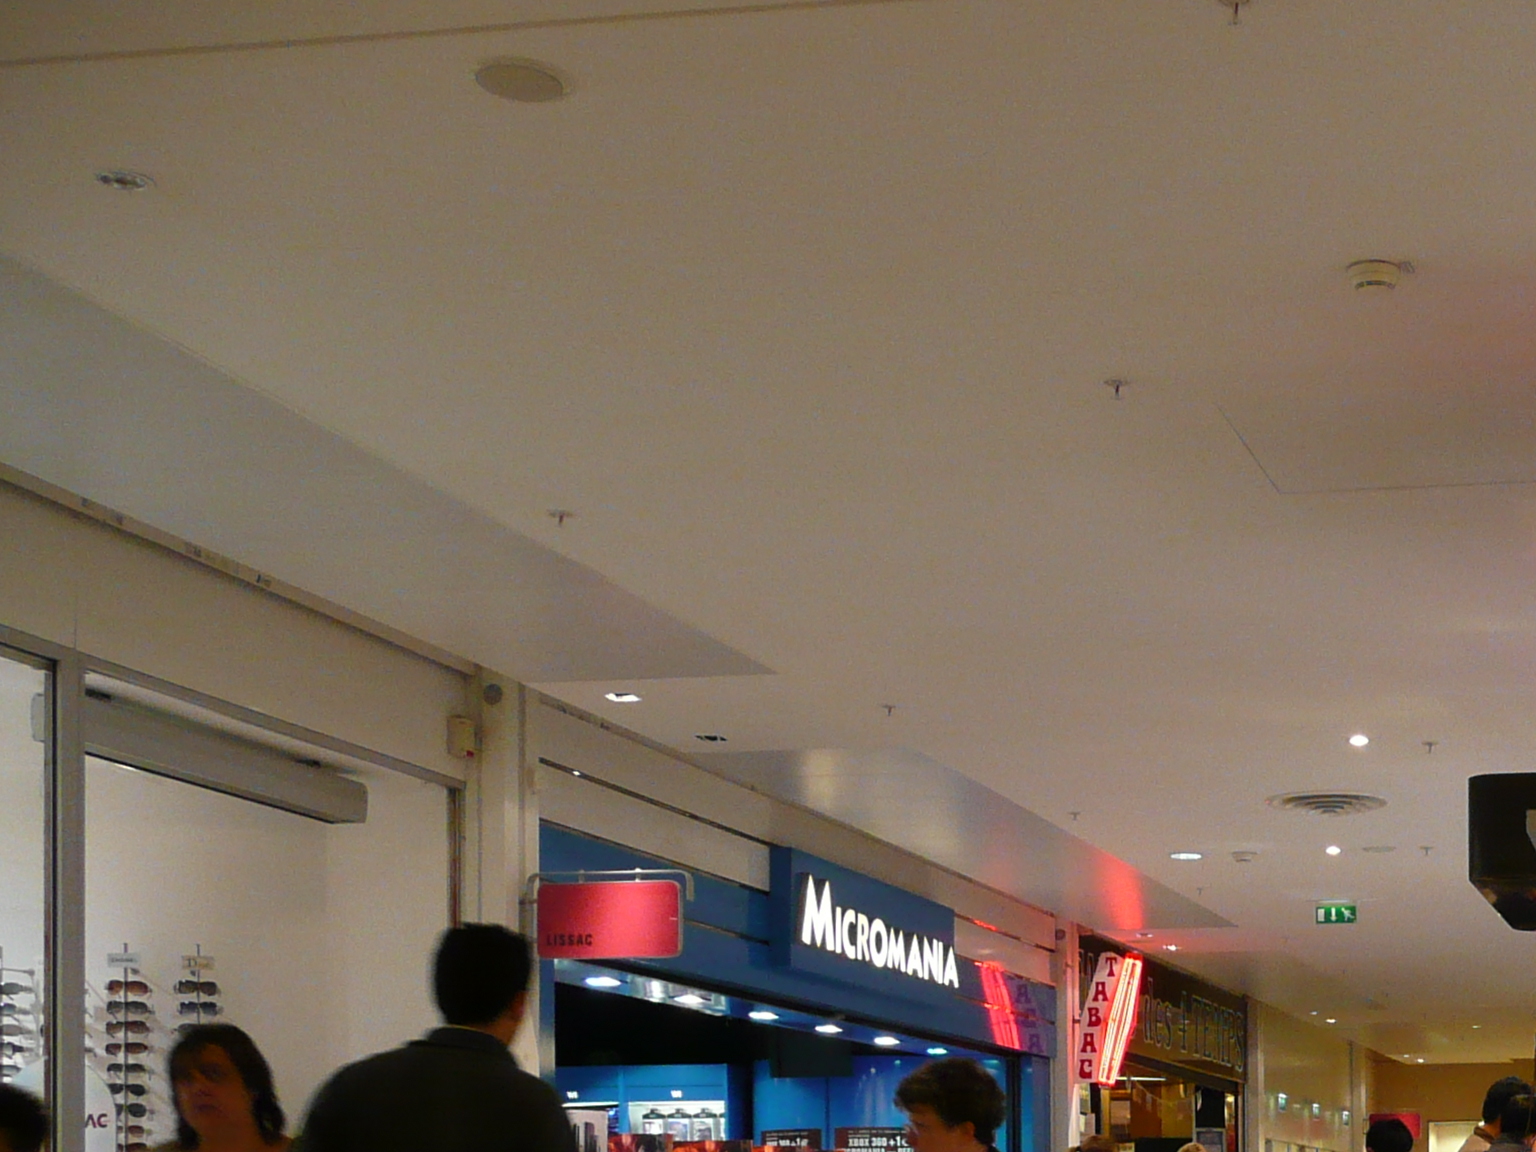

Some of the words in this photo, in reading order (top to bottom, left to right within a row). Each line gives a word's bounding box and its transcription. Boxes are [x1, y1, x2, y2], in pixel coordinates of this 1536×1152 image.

[547, 934, 593, 946] LISSAC
[1078, 956, 1117, 1079] TABAC
[1191, 995, 1244, 1072] TEMPS
